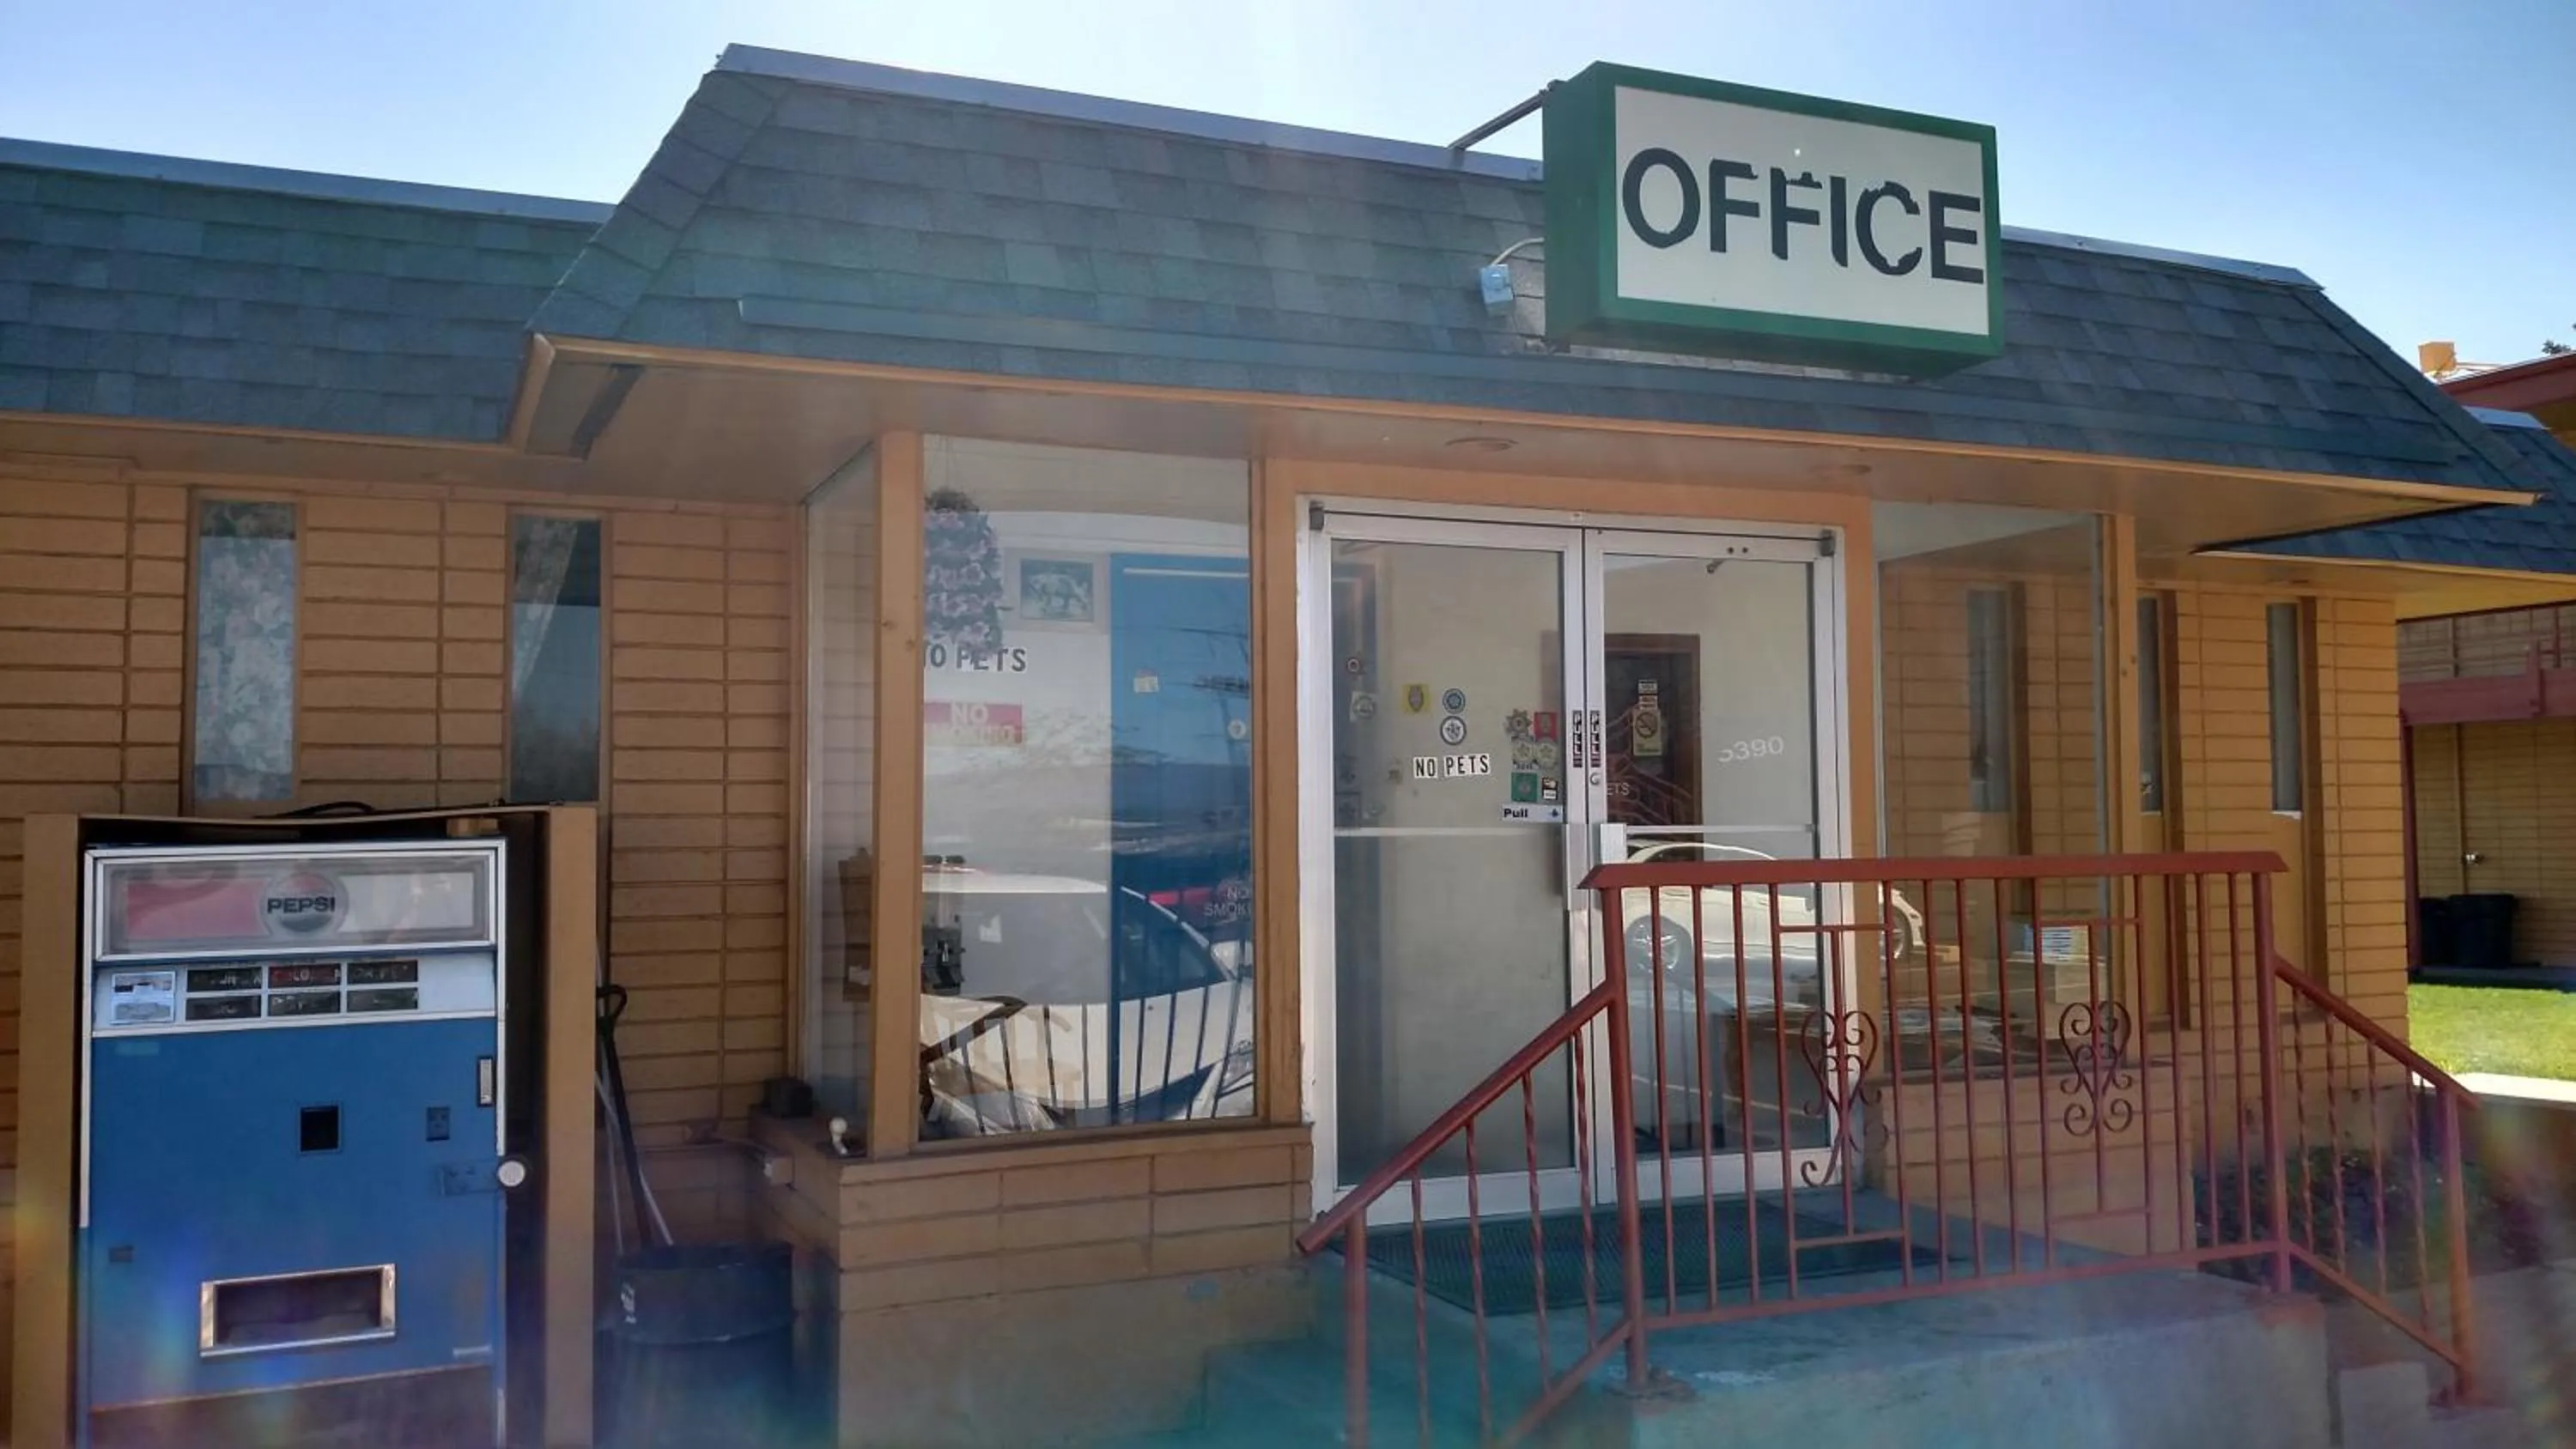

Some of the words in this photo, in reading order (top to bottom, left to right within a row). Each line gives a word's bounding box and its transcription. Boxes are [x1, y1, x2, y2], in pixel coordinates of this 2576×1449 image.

[1622, 147, 1984, 284] OFFICE
[924, 644, 946, 668] O
[951, 702, 989, 725] NO
[1416, 758, 1436, 777] NO
[1446, 755, 1489, 775] PETS
[1503, 808, 1528, 818] Pull
[267, 895, 336, 914] PEPSI
